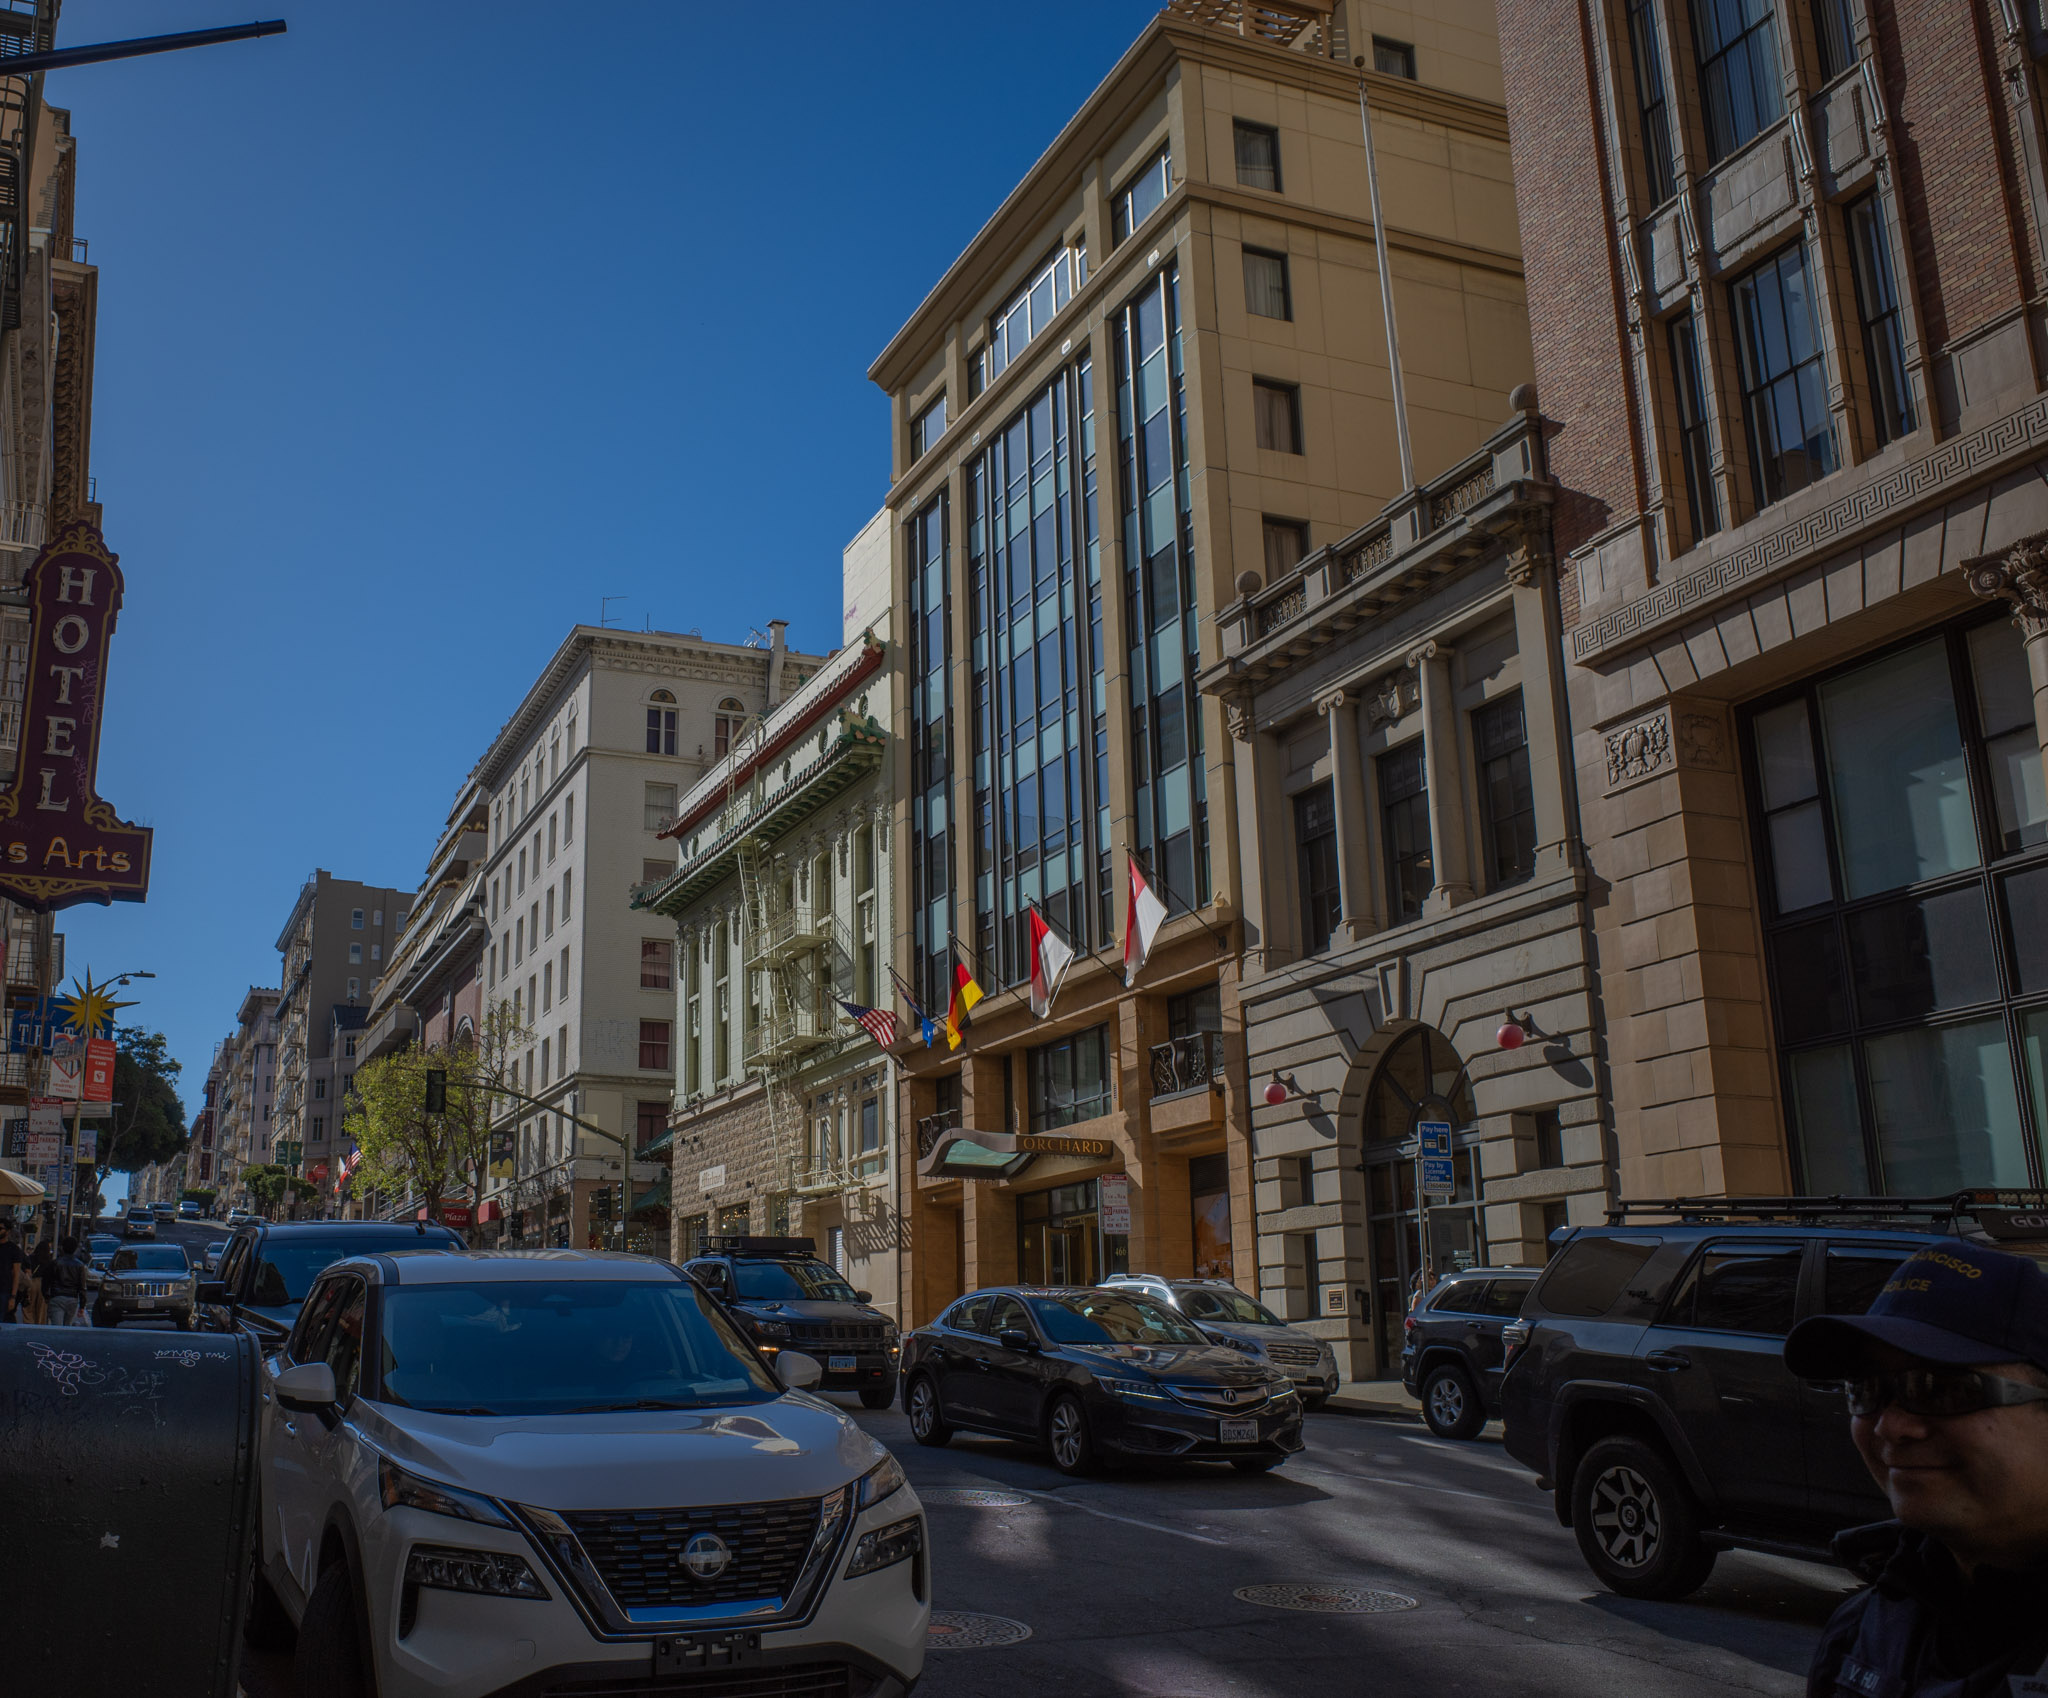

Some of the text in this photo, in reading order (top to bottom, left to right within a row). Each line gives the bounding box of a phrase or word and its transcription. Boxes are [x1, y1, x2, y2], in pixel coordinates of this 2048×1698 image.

[36, 565, 98, 812] HOTEL
[43, 836, 132, 872] Arts
[31, 1102, 40, 1110] NO
[1421, 1125, 1434, 1134] Pay
[29, 1134, 38, 1142] NO
[1023, 1137, 1104, 1154] ORCHARD
[1104, 1207, 1112, 1215] NO
[445, 1213, 467, 1221] Plaza
[1115, 1246, 1127, 1257] 466
